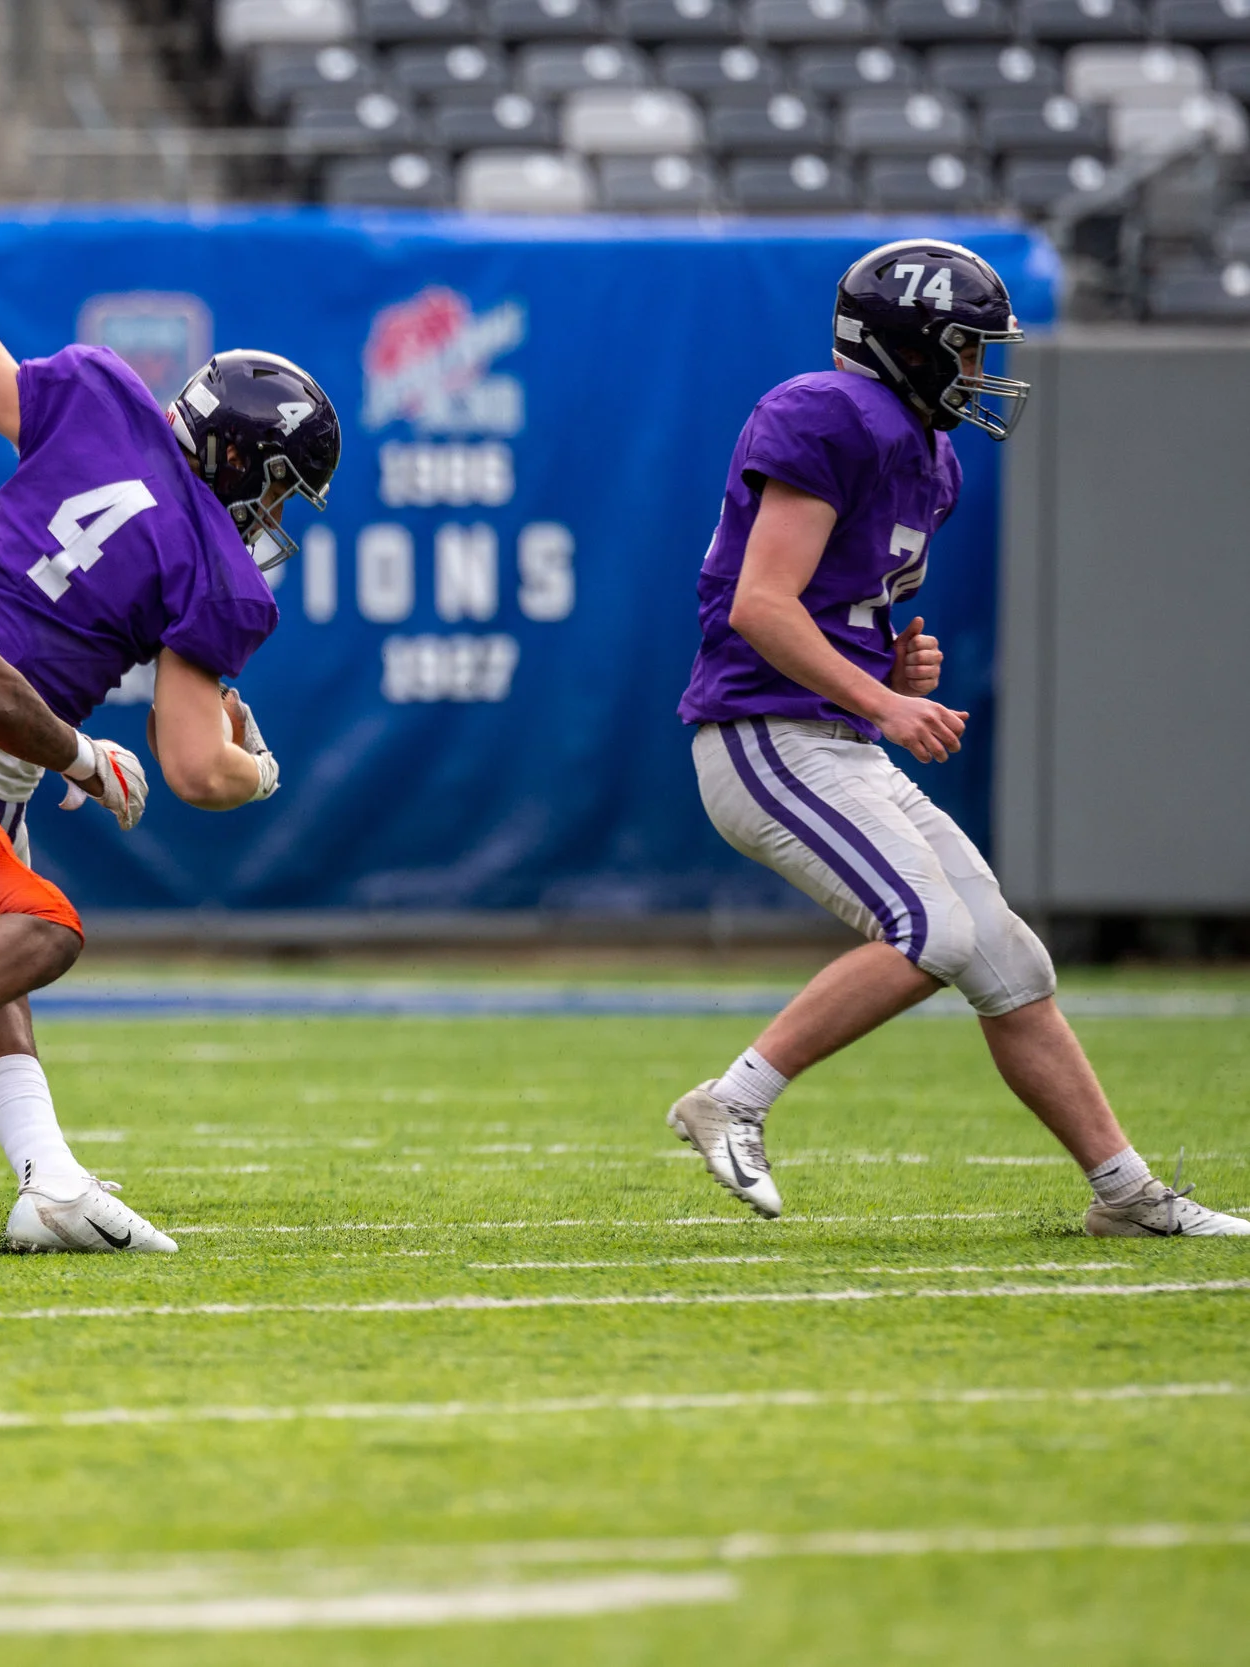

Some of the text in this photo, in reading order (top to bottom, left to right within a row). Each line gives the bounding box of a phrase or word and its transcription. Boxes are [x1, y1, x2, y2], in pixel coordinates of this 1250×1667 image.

[894, 264, 953, 311] 74
[275, 402, 313, 437] 4
[26, 479, 158, 603] 4
